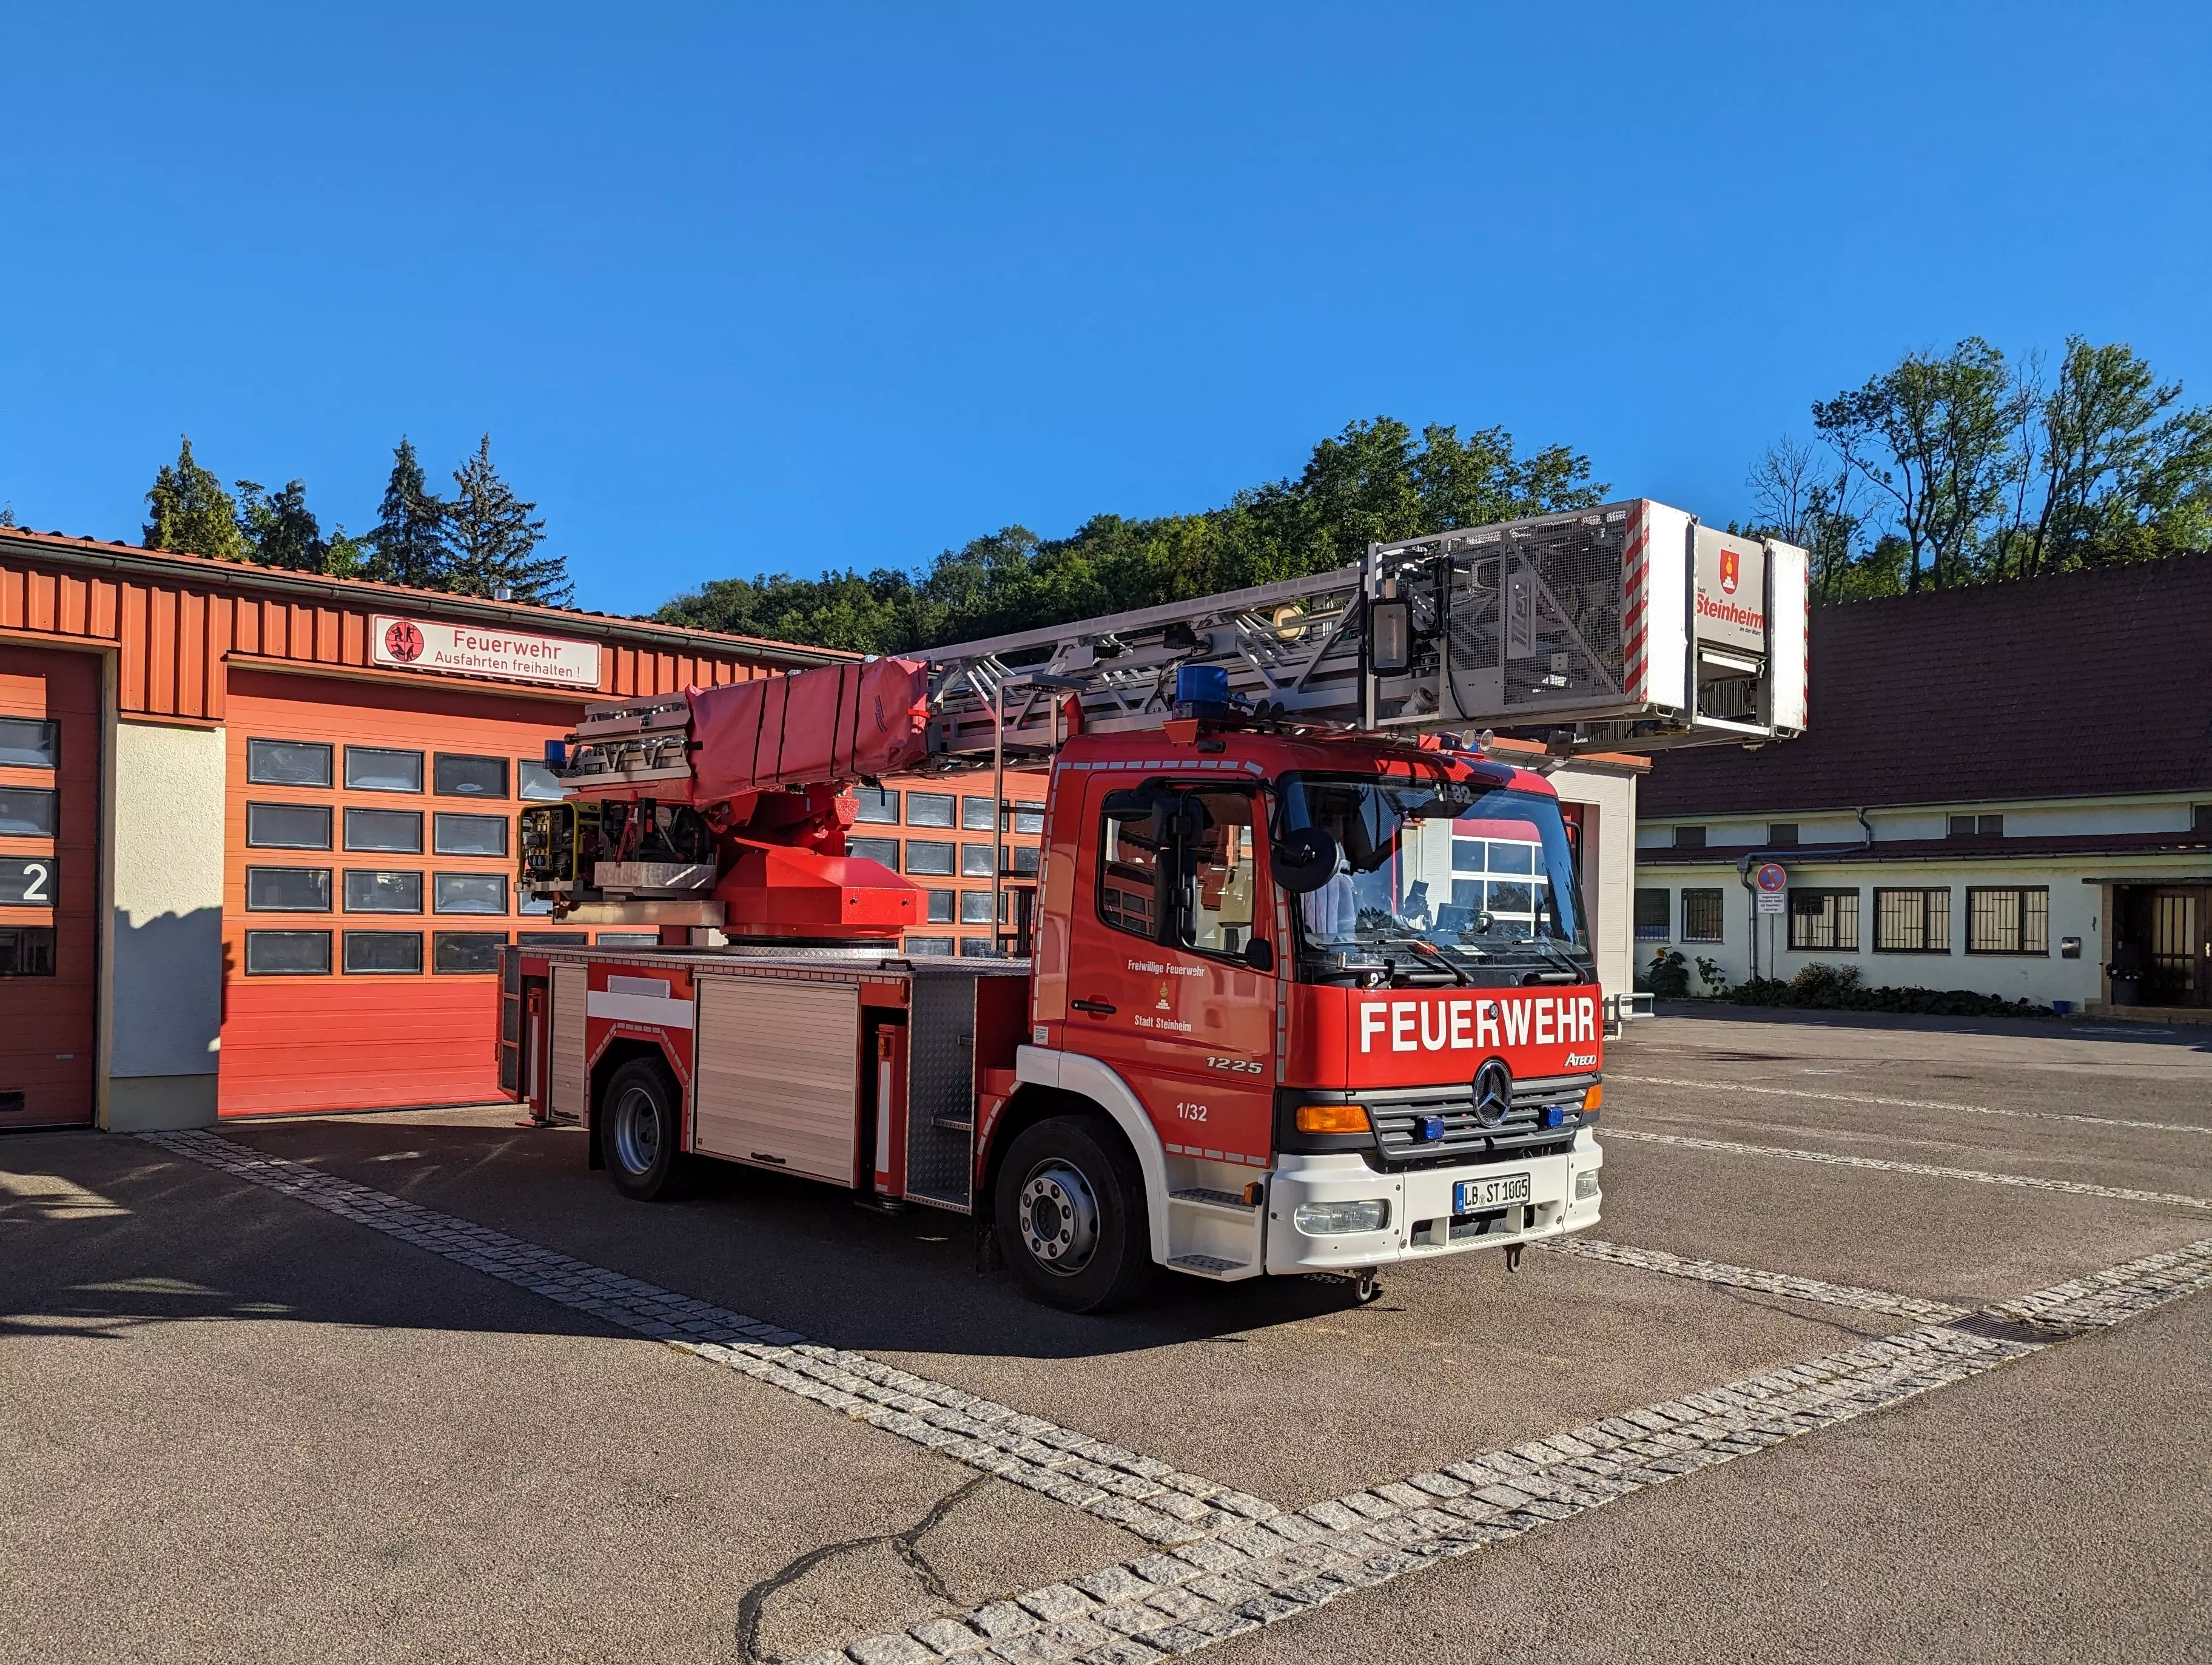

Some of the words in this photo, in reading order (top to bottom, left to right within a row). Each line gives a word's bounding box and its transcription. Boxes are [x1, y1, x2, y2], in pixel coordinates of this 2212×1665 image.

[1697, 593, 1763, 629] Steinheim
[454, 630, 562, 659] Feuerwehr
[434, 651, 508, 670] Ausfahrten
[513, 659, 573, 678] freihalten
[24, 864, 47, 900] 2
[1128, 960, 1163, 974] Freiwillige
[1166, 963, 1205, 977] Feuerwehr
[1135, 1015, 1153, 1028] Stadt
[1156, 1017, 1191, 1032] Steinheim
[1360, 997, 1595, 1052] FEUERWEHR
[1206, 1056, 1263, 1074] 1225
[1177, 1103, 1207, 1122] 1/32
[1465, 1186, 1478, 1206] LB
[1487, 1183, 1499, 1202] ST
